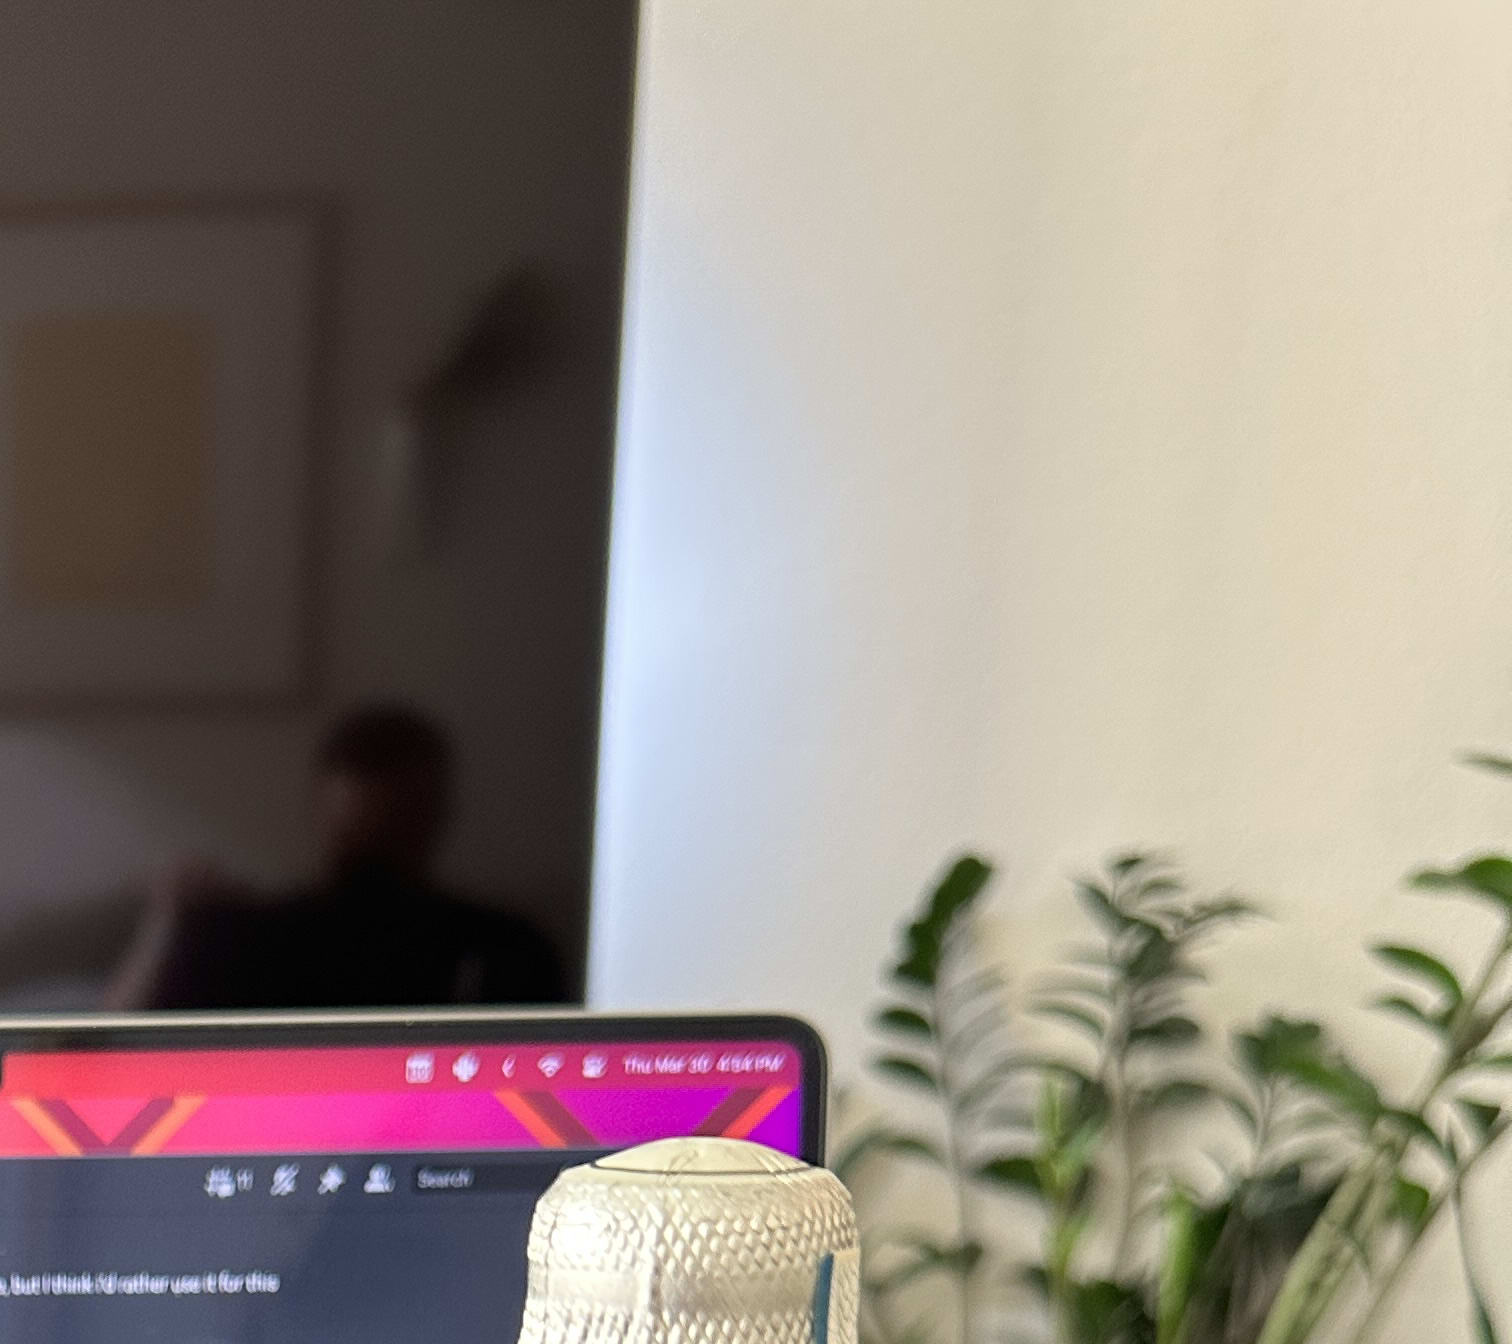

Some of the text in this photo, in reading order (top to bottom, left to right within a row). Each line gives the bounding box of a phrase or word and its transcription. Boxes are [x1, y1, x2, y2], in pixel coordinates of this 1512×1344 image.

[624, 1052, 654, 1073] Thu
[654, 1052, 688, 1073] Mar
[752, 1051, 785, 1073] PM
[417, 1167, 474, 1189] Search
[10, 1272, 40, 1294] but
[51, 1272, 93, 1294] think
[118, 1271, 169, 1294] rather
[170, 1275, 202, 1294] use
[218, 1271, 245, 1293] for
[245, 1271, 280, 1293] this
